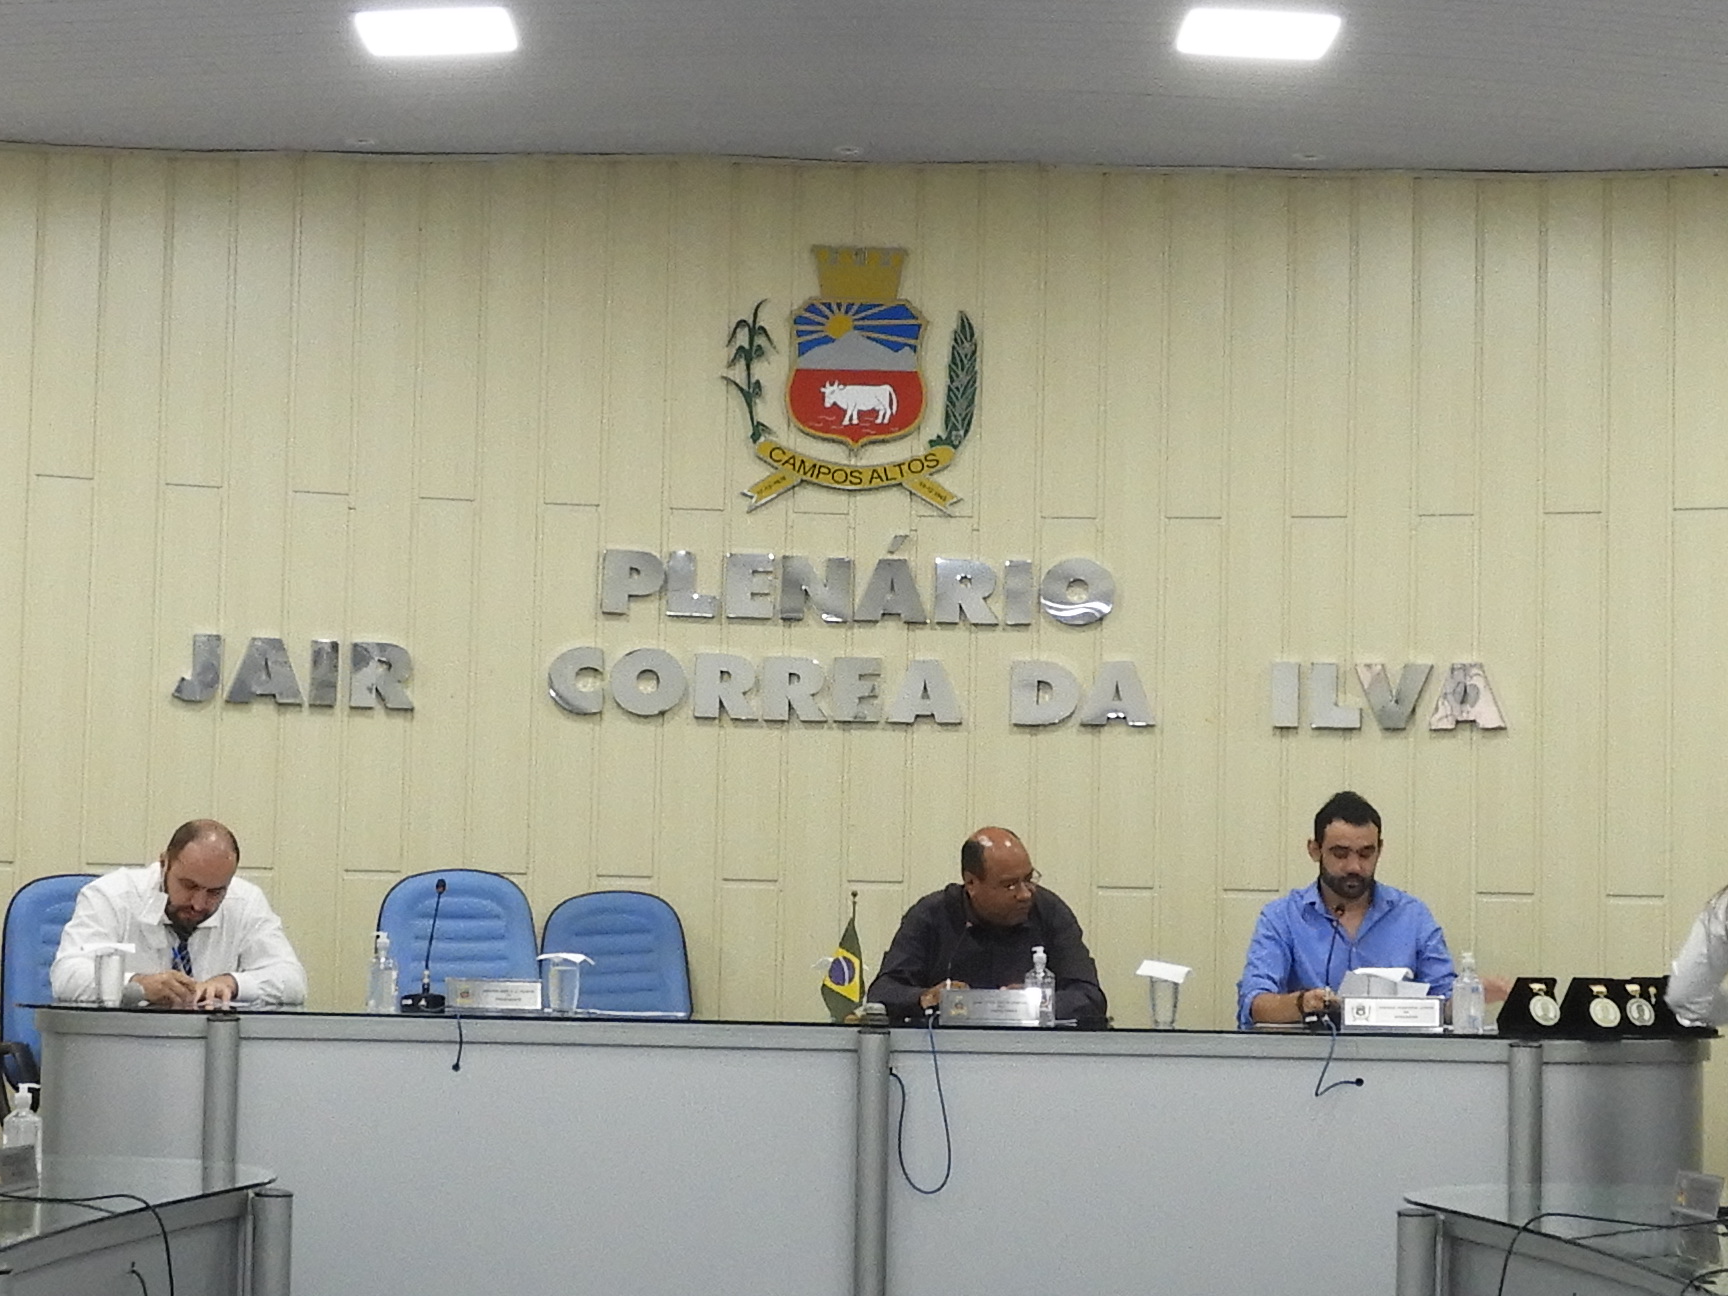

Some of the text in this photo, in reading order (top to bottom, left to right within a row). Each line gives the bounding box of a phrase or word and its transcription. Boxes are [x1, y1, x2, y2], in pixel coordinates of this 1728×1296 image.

[769, 446, 863, 486] CAMPOS
[868, 452, 940, 485] ALTOS
[600, 534, 1117, 626] PLENÁRIO
[172, 633, 1508, 731] JAIR CORREA DA ILVA
